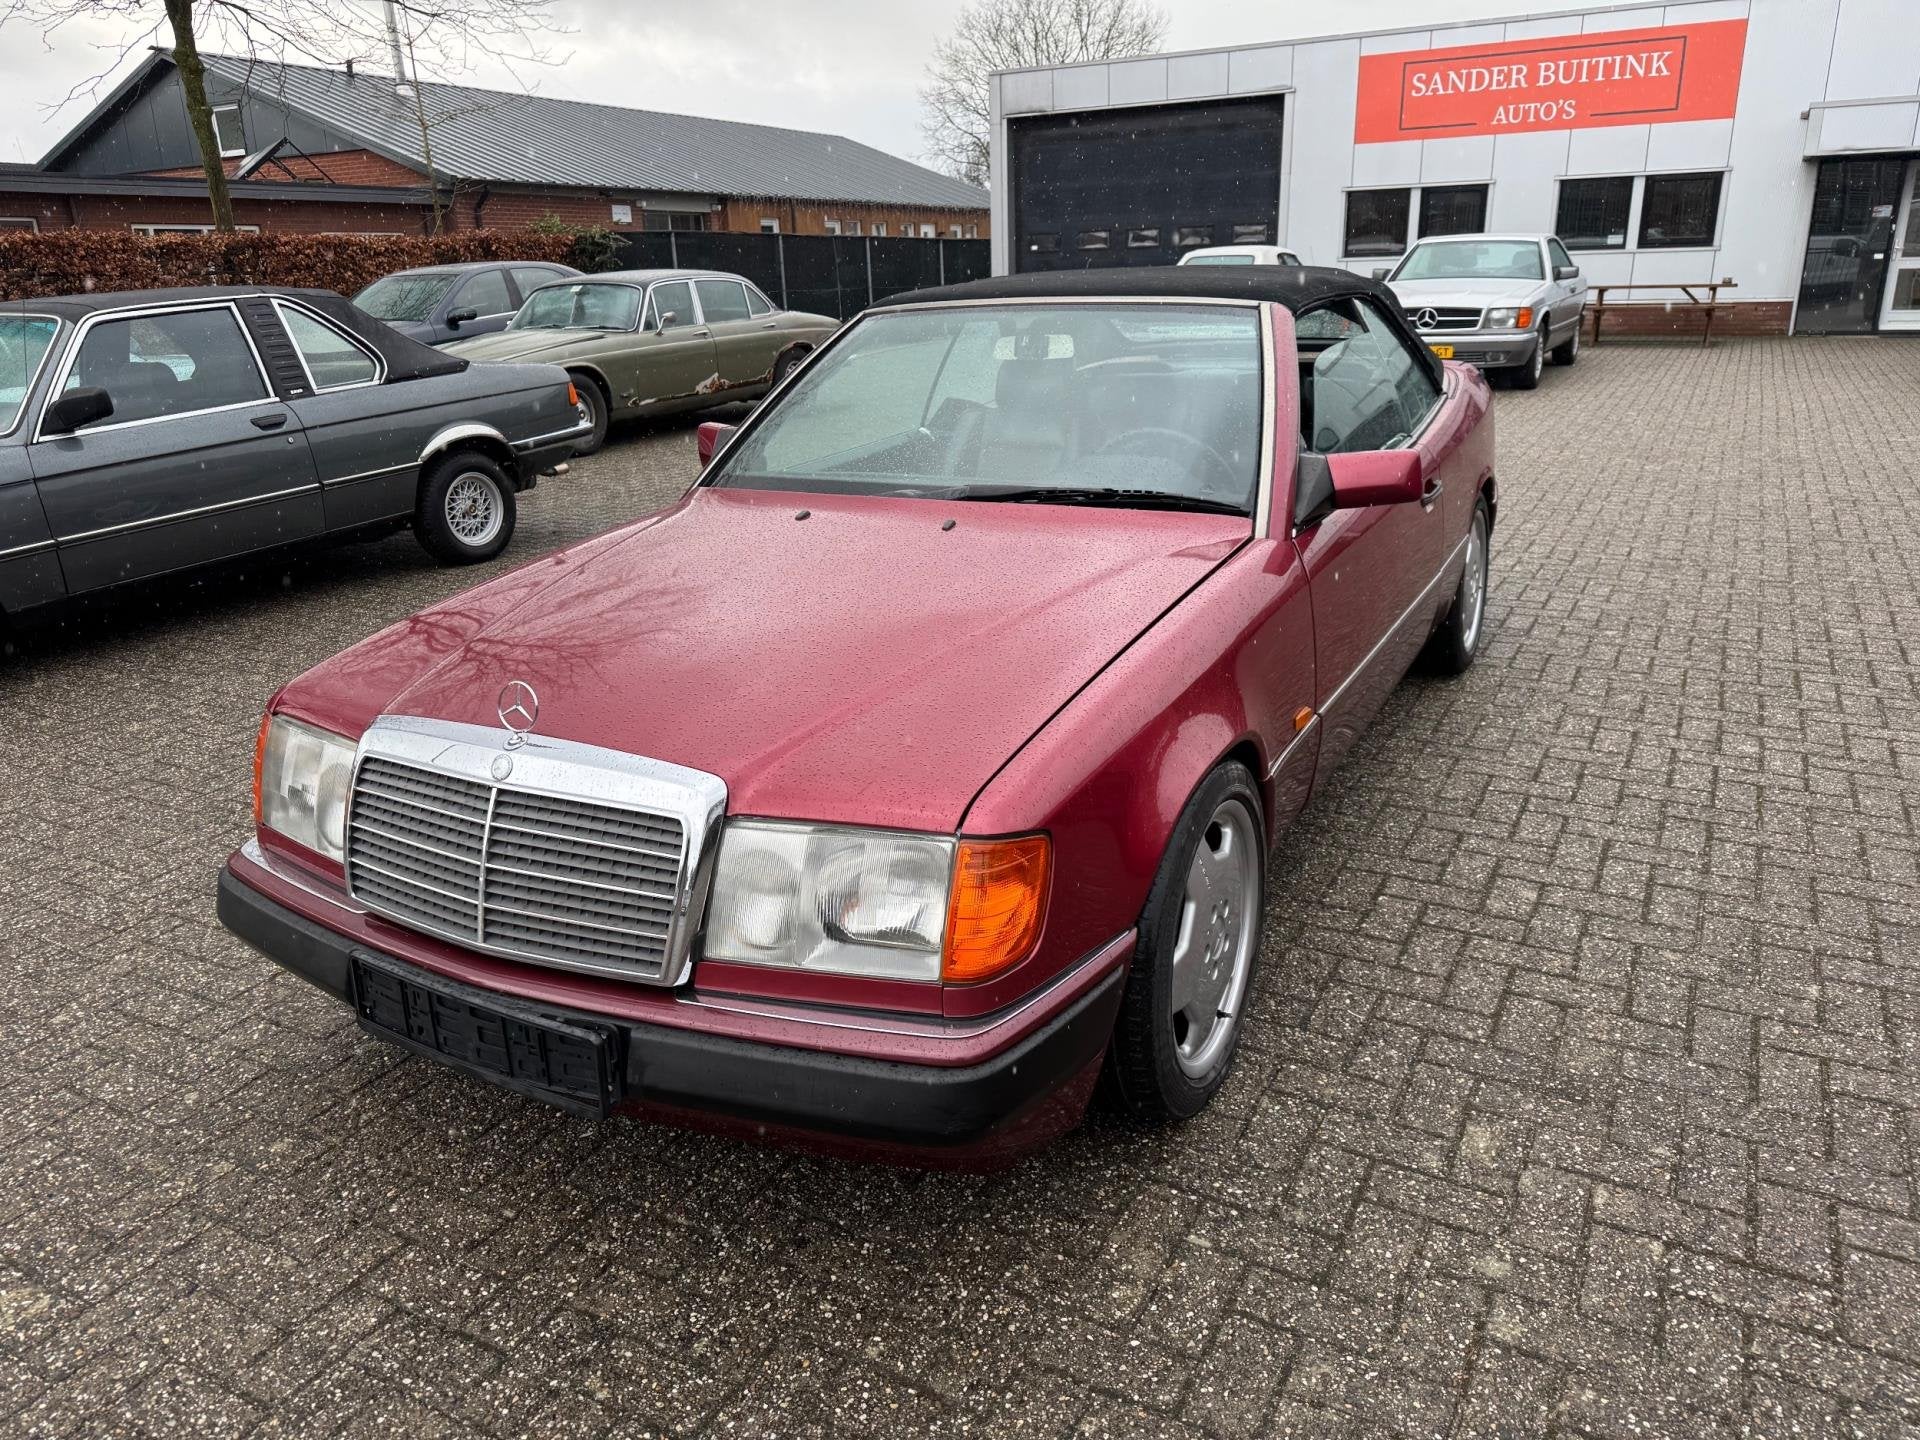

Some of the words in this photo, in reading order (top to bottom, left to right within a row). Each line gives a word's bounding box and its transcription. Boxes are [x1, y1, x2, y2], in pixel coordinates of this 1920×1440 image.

[1411, 65, 1528, 97] SANDER
[1537, 51, 1673, 87] BUITINK
[1491, 99, 1576, 125] AUTO'S
